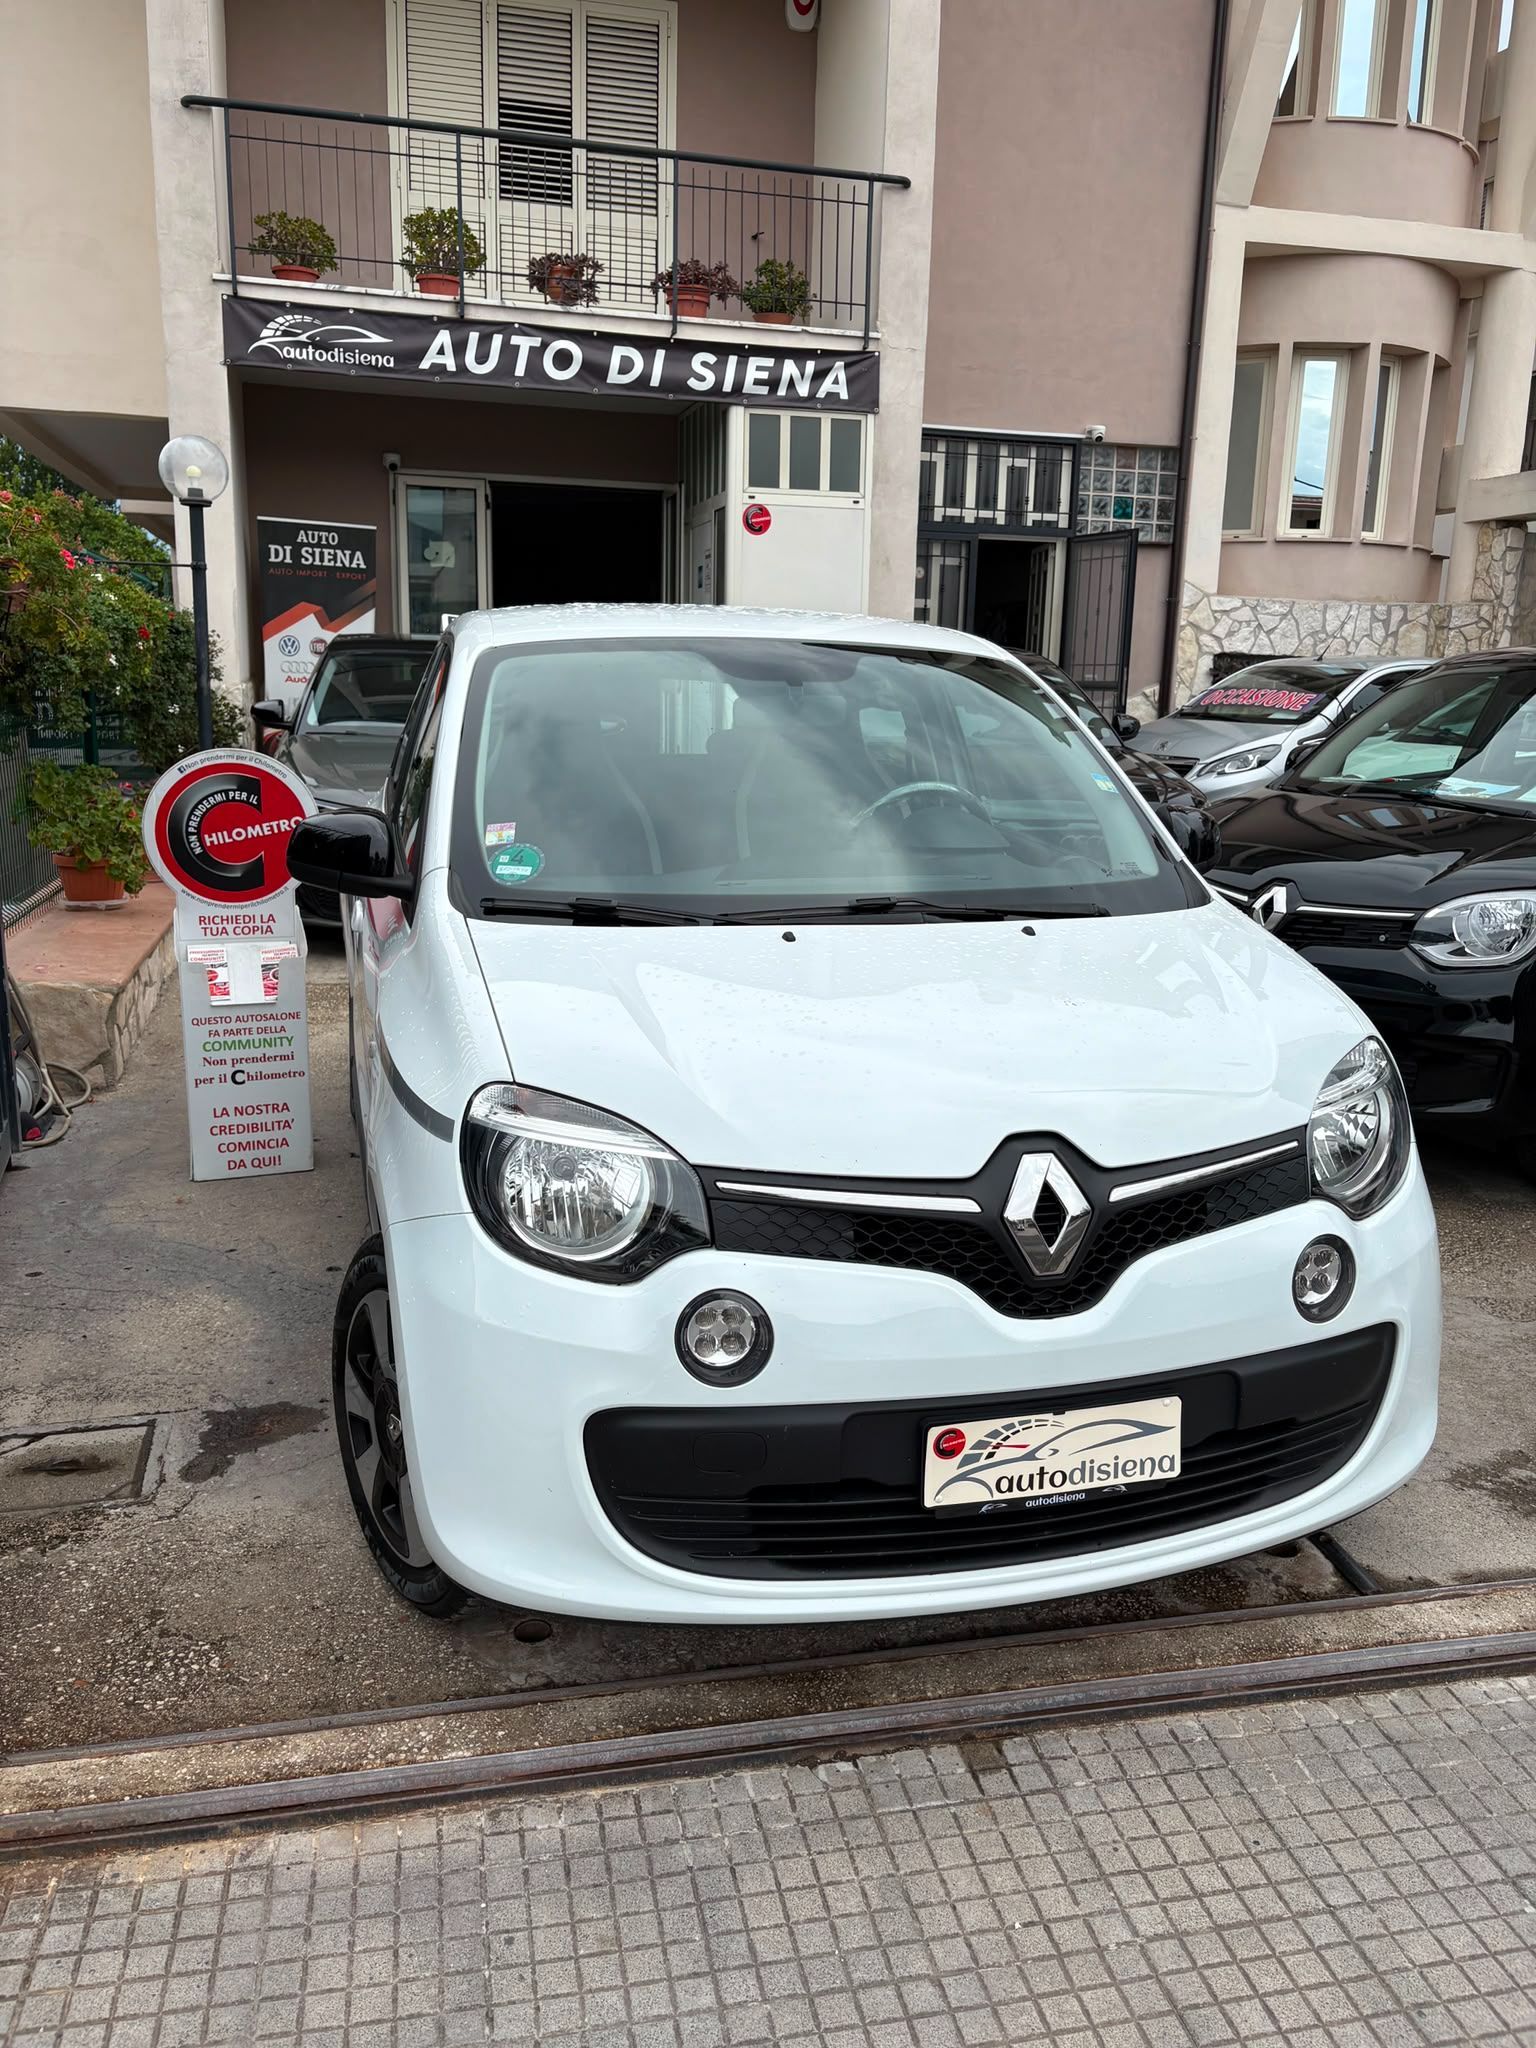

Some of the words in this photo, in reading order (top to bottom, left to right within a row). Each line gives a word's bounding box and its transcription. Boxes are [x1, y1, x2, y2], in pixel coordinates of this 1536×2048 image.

[282, 344, 394, 369] autodisiena
[418, 329, 583, 381] AUTO
[606, 345, 666, 387] DI
[686, 351, 849, 400] SIENA
[296, 530, 338, 545] AUTO
[268, 544, 293, 563] DI
[301, 547, 367, 569] SIENA
[269, 567, 293, 576] AUTO
[296, 569, 328, 577] IMPORT
[336, 571, 367, 580] EXPORT
[285, 676, 309, 684] Aud
[1201, 688, 1317, 711] OCCASIONE
[186, 760, 199, 769] Non
[200, 755, 234, 764] prendermi
[254, 758, 288, 779] Chilometro
[228, 791, 247, 801] PER
[249, 794, 259, 805] IL
[187, 791, 227, 833] PRENDERMI
[188, 833, 203, 855] NON
[198, 914, 256, 926] RICHIEDI
[260, 913, 277, 924] LA
[201, 927, 229, 937] TUA
[233, 925, 274, 936] COPIA
[191, 1015, 232, 1027] QUESTO
[235, 1011, 301, 1023] AUTOSALONE
[208, 1029, 220, 1038] FA
[223, 1027, 254, 1037] PARTE
[256, 1025, 286, 1035] DELLA
[202, 1036, 294, 1052] COMMUNITY
[202, 1056, 227, 1067] Non
[231, 1051, 295, 1067] prendermi
[194, 1074, 215, 1088] per
[219, 1073, 227, 1084] il
[231, 1069, 305, 1085] Chilometro
[213, 1107, 230, 1119] LA
[234, 1102, 290, 1117] NOSTRA
[209, 1118, 295, 1136] CREDIBILITA'
[217, 1137, 290, 1153] COMINCIA
[227, 1159, 247, 1170] DA
[251, 1154, 282, 1169] QUI!
[995, 1454, 1176, 1495] autodisiena
[1025, 1491, 1086, 1508] autodisiena
